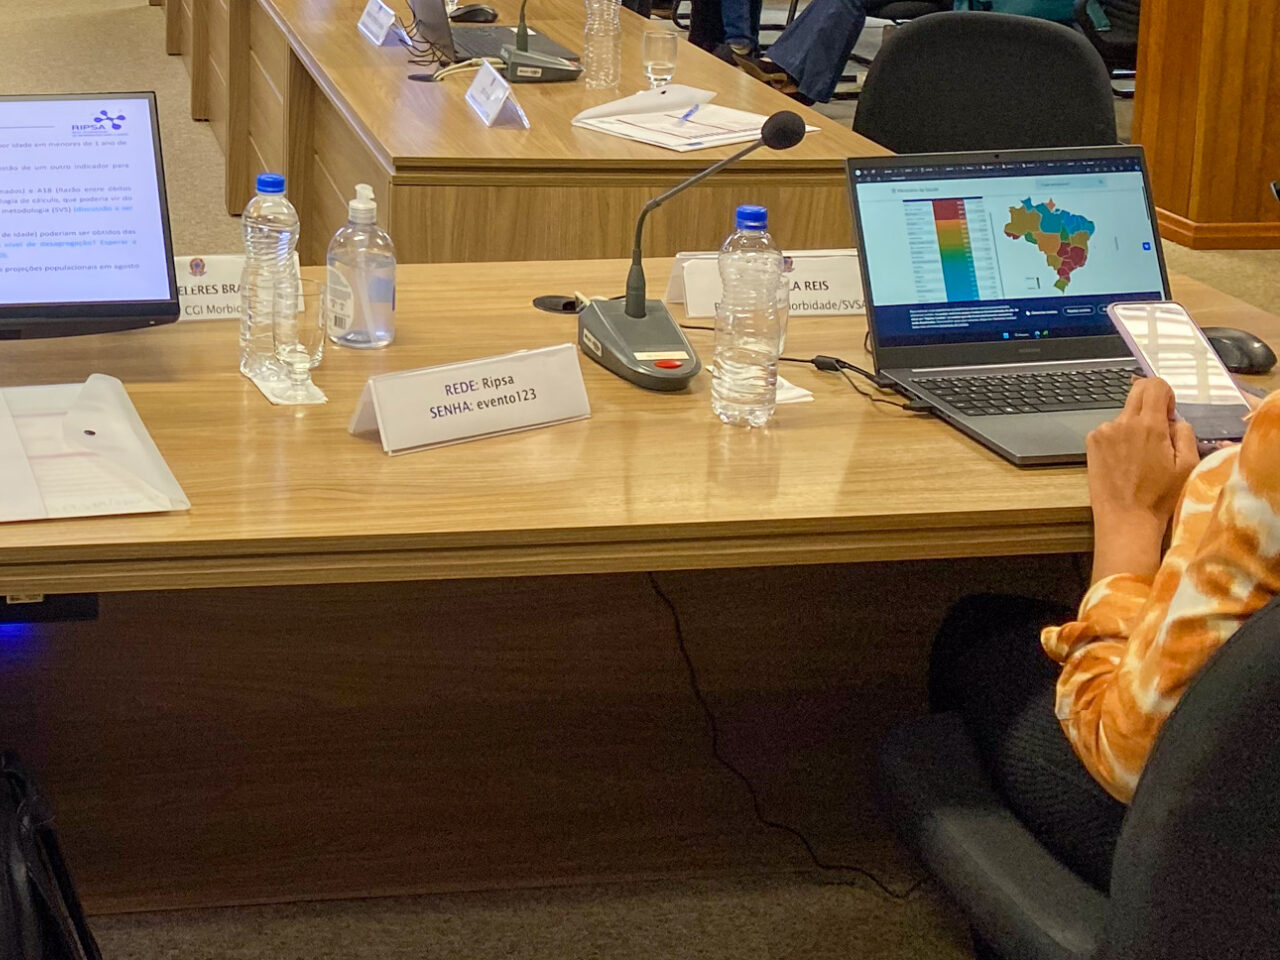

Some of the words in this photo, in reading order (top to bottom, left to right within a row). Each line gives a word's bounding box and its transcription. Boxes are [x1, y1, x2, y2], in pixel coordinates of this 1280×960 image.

[789, 281, 801, 291] A
[804, 281, 829, 291] REIS
[184, 305, 204, 316] CGI
[789, 300, 866, 311] orbidade/SVSA
[444, 380, 480, 396] REDE:
[481, 375, 515, 390] Ripsa
[429, 400, 474, 419] SENHA:
[476, 388, 537, 410] evento123
